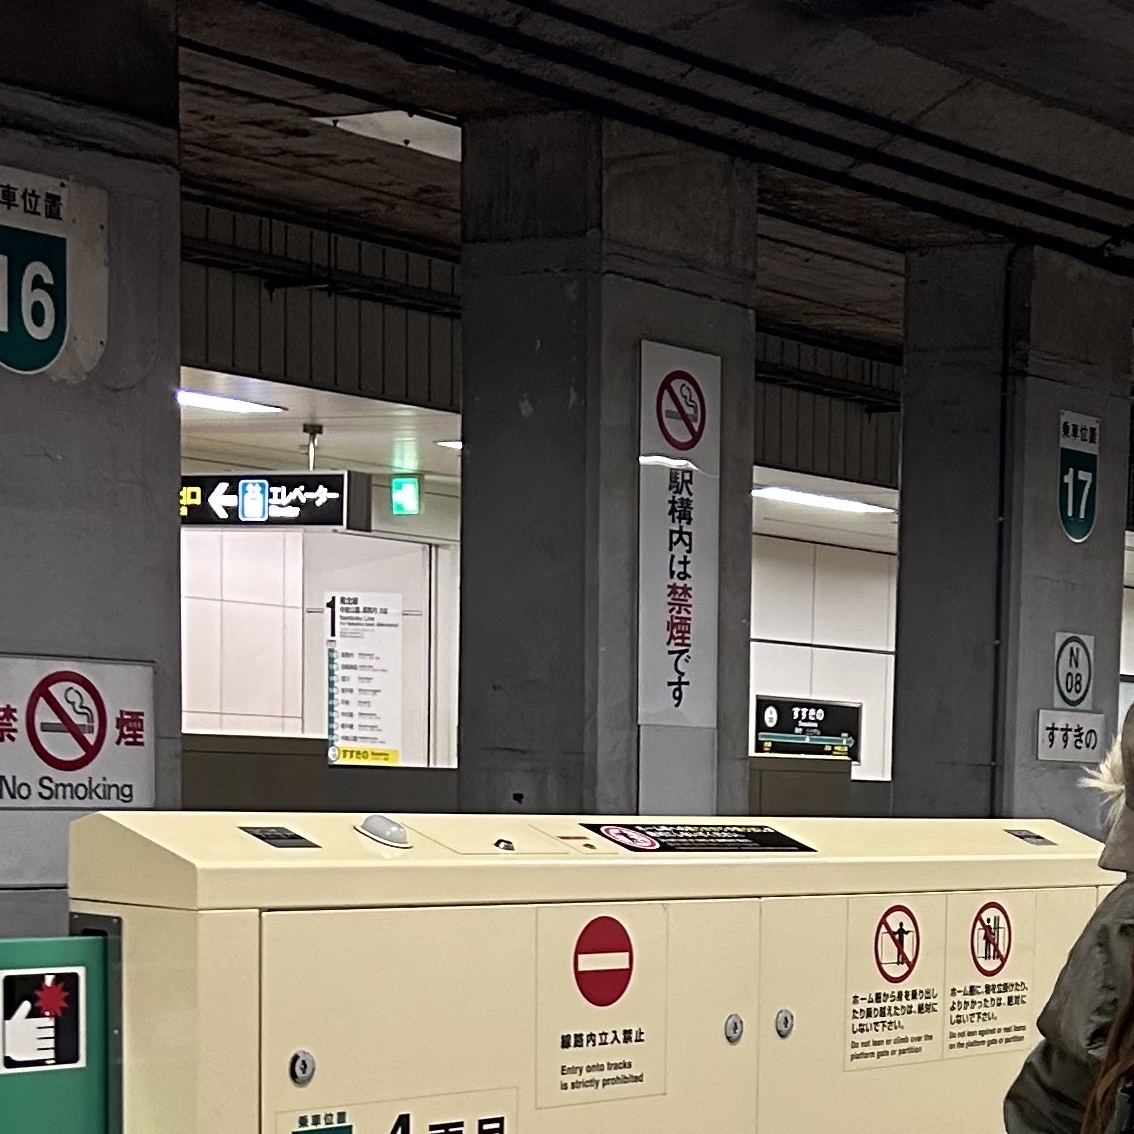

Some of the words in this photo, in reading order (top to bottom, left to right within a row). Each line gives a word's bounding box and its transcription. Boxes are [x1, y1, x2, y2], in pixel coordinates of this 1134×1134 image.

[1063, 467, 1093, 519] 17
[666, 468, 694, 709] 駅構内は禁煙です
[326, 596, 336, 637] 1
[1068, 646, 1080, 669] N
[1065, 672, 1082, 694] 08
[115, 709, 145, 747] 煙
[1045, 722, 1097, 750] すすきの
[0, 774, 31, 800] No
[38, 775, 134, 803] Smoking
[560, 1027, 646, 1049] 線路内立入禁止
[560, 1064, 584, 1076] Entry
[586, 1062, 605, 1073] onto
[607, 1060, 632, 1070] tracks
[560, 1080, 568, 1090] is
[571, 1077, 600, 1089] strictly
[602, 1072, 644, 1089] prohibited
